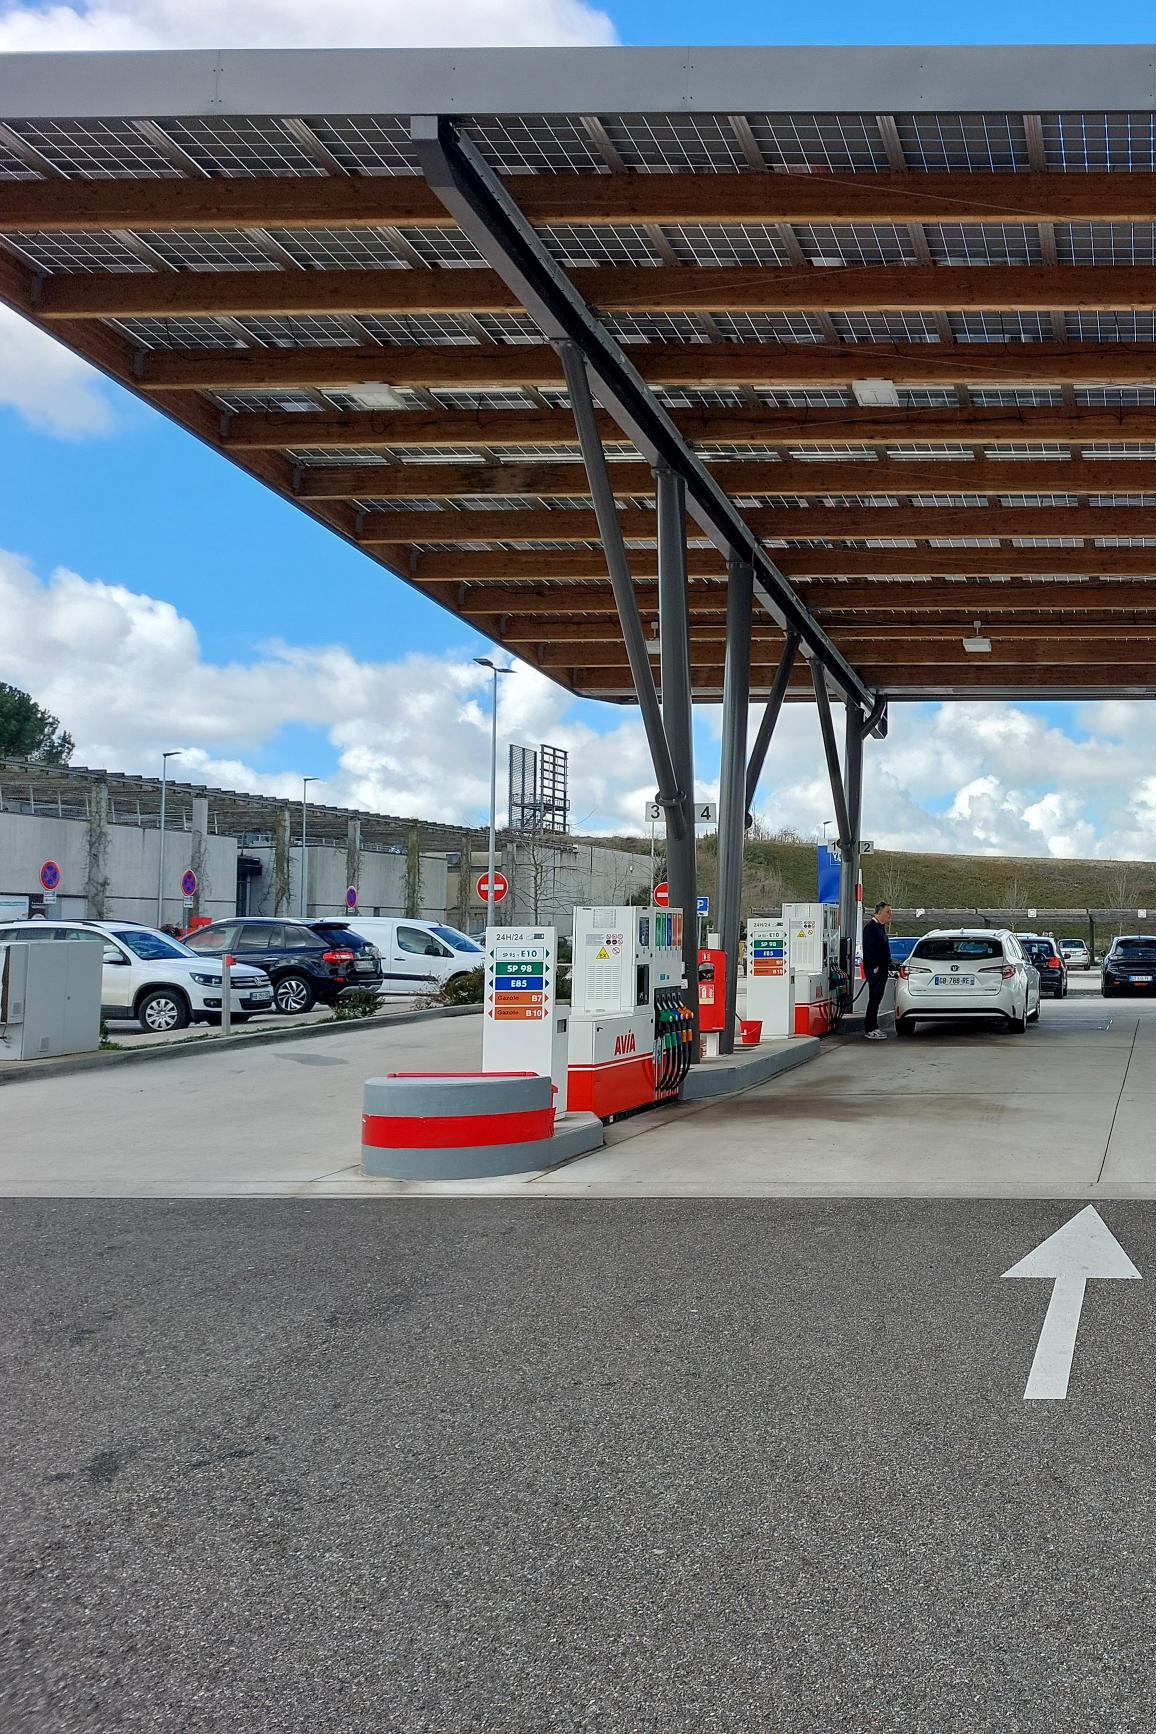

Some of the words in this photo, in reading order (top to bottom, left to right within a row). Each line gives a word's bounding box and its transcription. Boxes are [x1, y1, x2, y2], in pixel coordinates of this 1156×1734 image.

[650, 804, 660, 818] 3
[700, 806, 711, 820] 4
[831, 842, 836, 850] 1
[864, 843, 870, 852] 2
[696, 900, 704, 909] P
